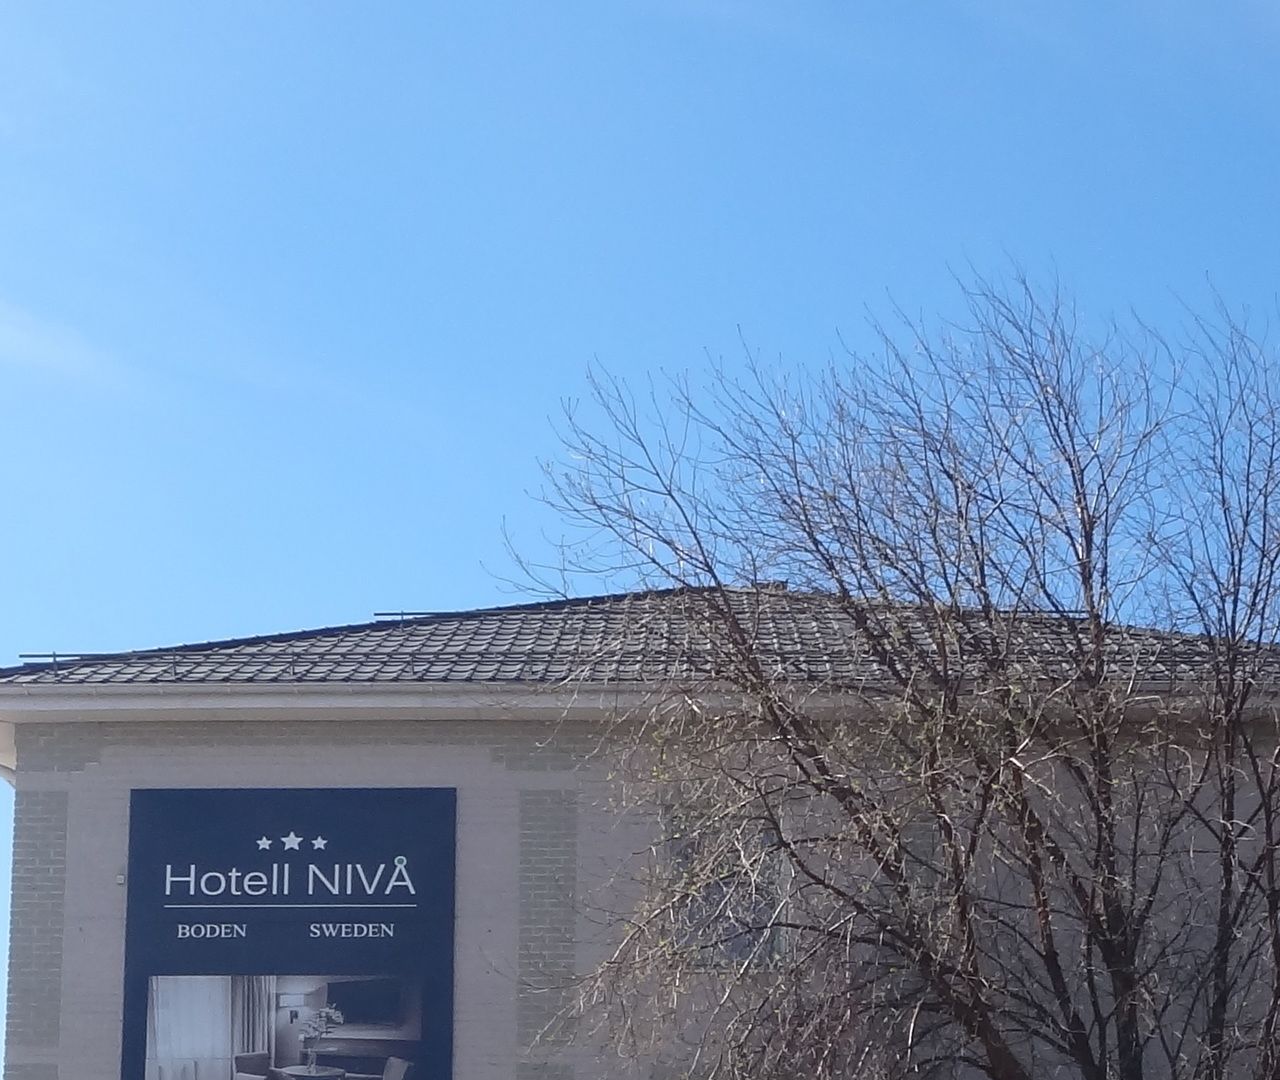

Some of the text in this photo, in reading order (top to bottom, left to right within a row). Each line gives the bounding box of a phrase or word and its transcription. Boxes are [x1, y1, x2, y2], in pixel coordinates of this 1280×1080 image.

[165, 855, 416, 896] Hotell NIVÅ
[177, 923, 395, 938] BODEN SWEDEN
